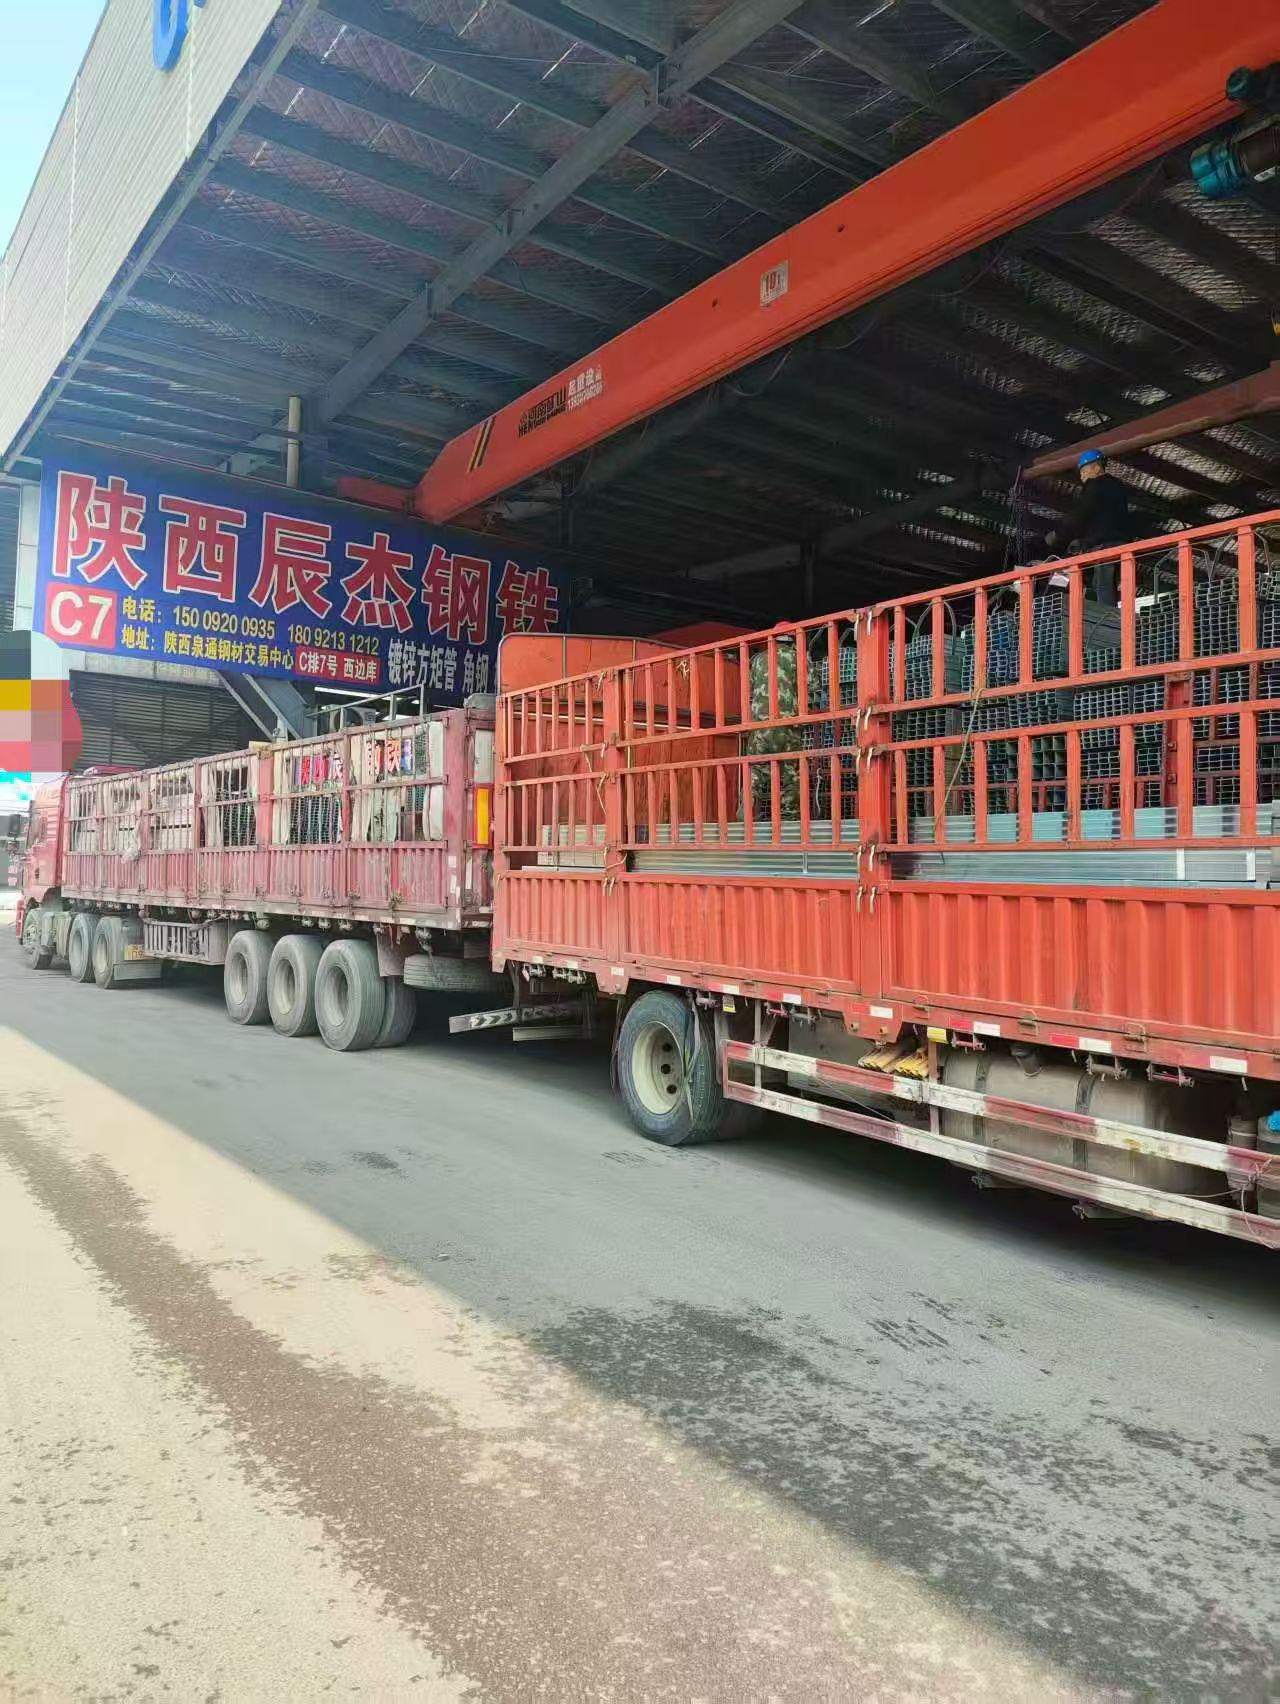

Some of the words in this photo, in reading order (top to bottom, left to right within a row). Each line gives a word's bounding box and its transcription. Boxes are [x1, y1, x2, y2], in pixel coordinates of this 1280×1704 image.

[52, 470, 560, 643] 陕西辰杰钢铁
[50, 590, 113, 640] C7
[173, 605, 199, 628] 150
[203, 611, 238, 634] 0920
[241, 616, 275, 640] 0935
[288, 624, 311, 645] 180
[314, 628, 345, 649] 9213
[351, 634, 379, 655] 1212
[299, 651, 338, 677] C排7号
[343, 656, 378, 682] 西边库
[388, 637, 457, 692] 镀锌方矩管
